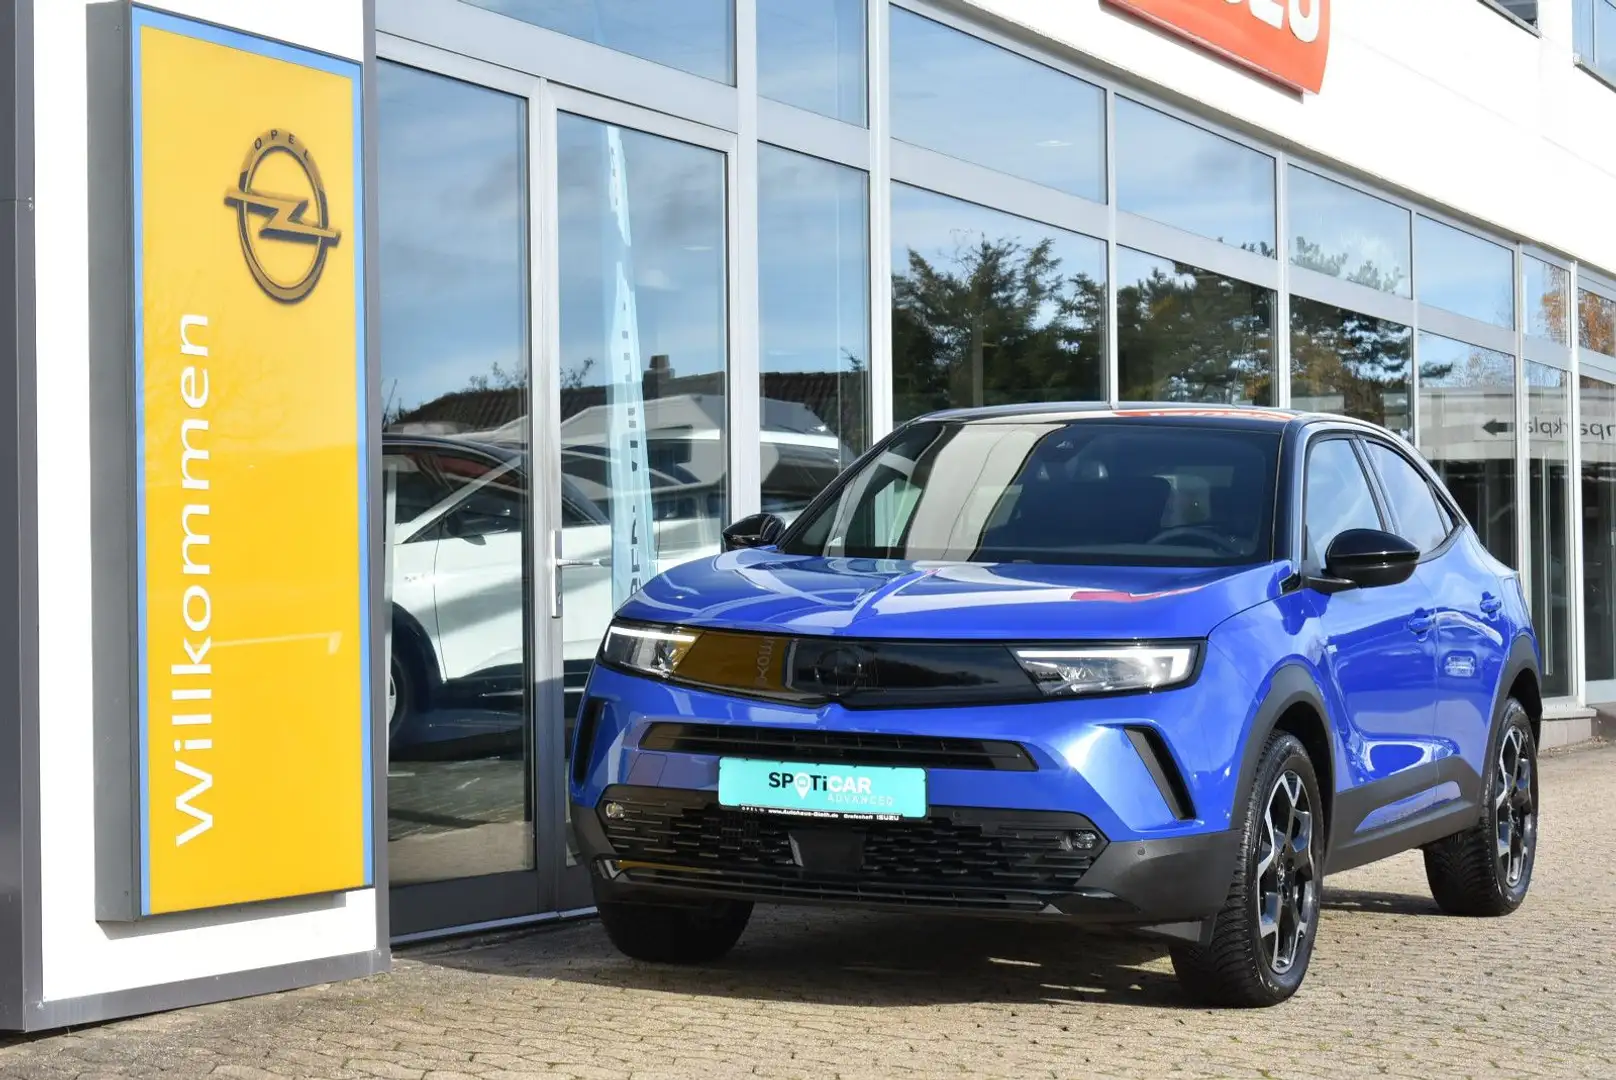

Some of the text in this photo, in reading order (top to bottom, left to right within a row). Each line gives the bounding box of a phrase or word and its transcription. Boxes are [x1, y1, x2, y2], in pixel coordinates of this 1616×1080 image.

[254, 129, 309, 161] OPEL
[171, 314, 213, 847] Willkommen
[827, 793, 894, 806] ADVANCED
